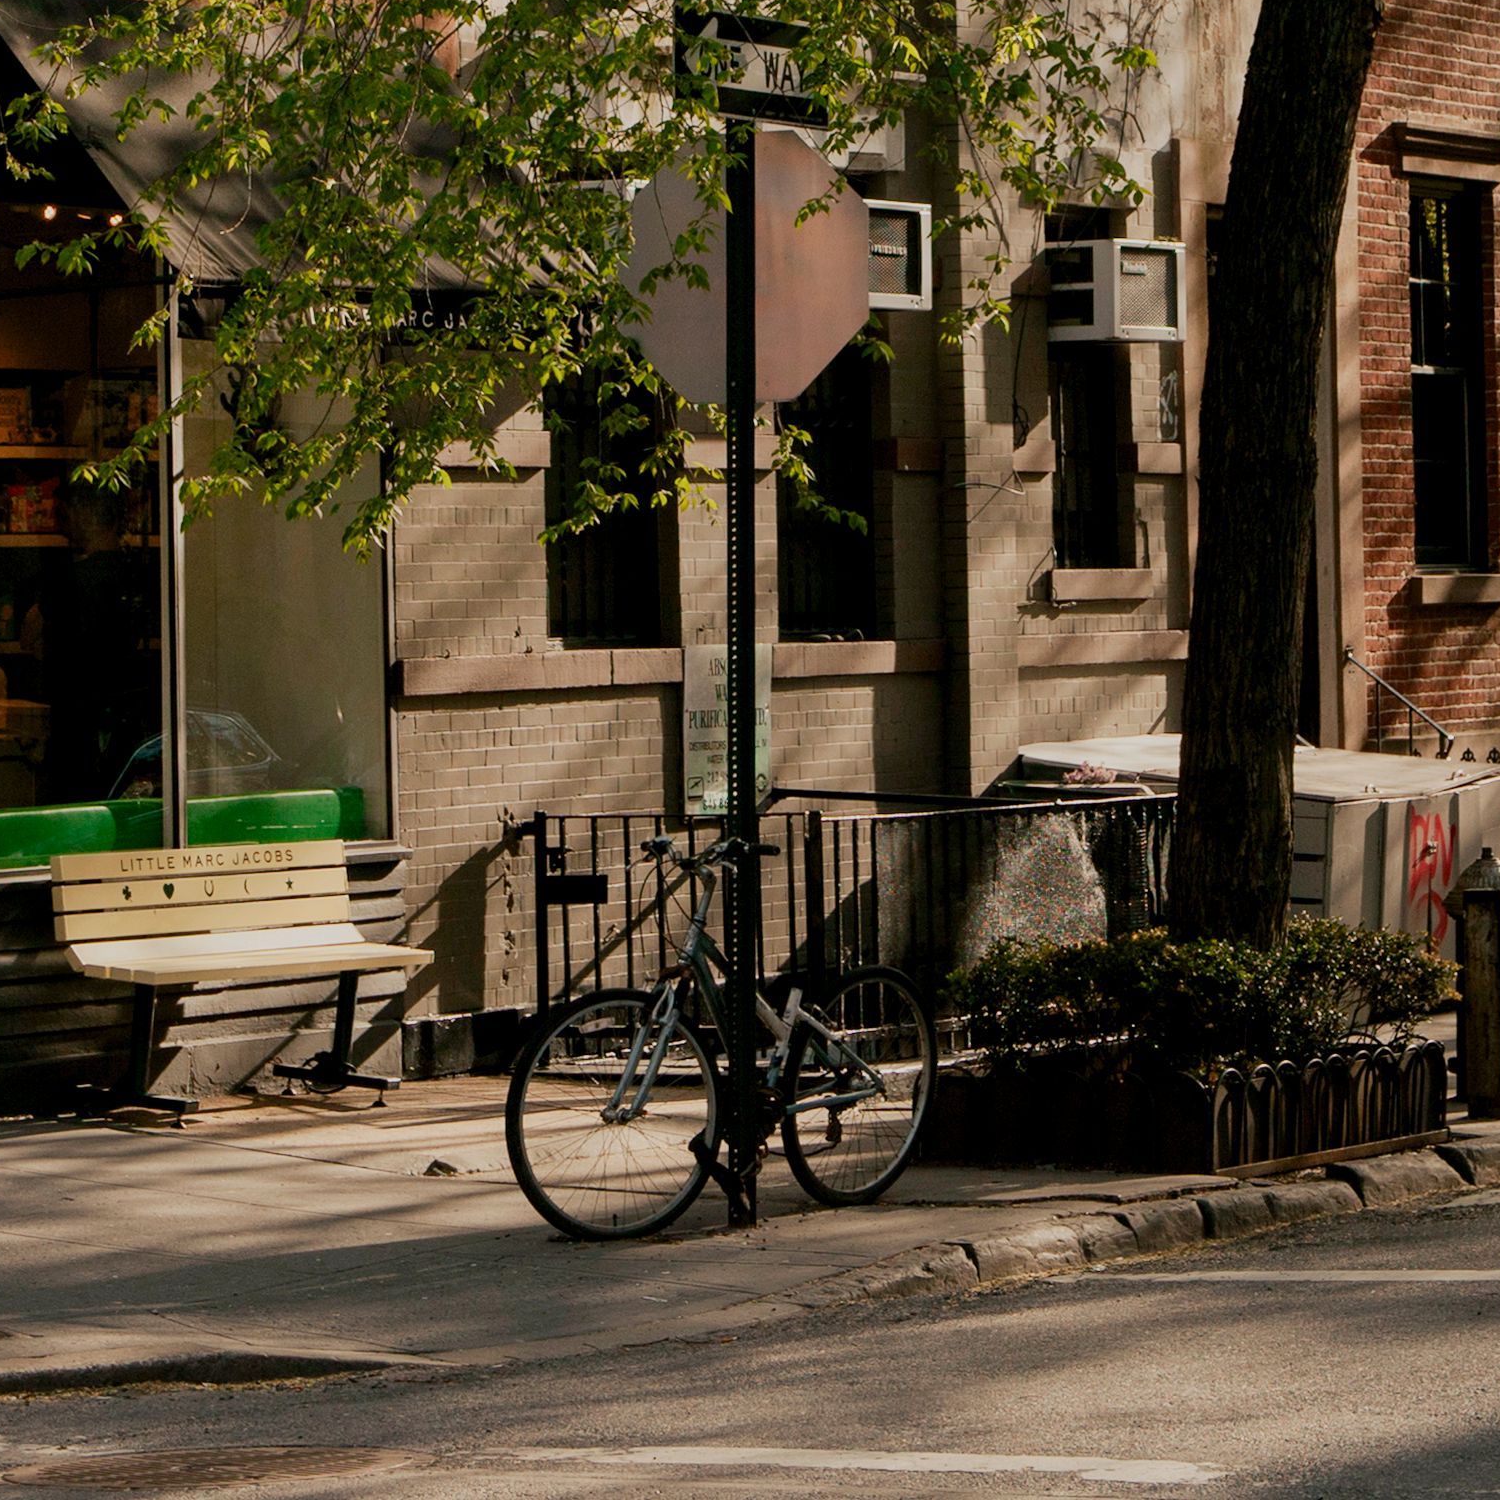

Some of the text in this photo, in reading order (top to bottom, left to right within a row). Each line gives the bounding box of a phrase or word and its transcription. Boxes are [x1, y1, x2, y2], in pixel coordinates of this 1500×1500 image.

[688, 708, 728, 730] PURIFICA
[120, 849, 294, 872] LITTLE MARC JACOBS
